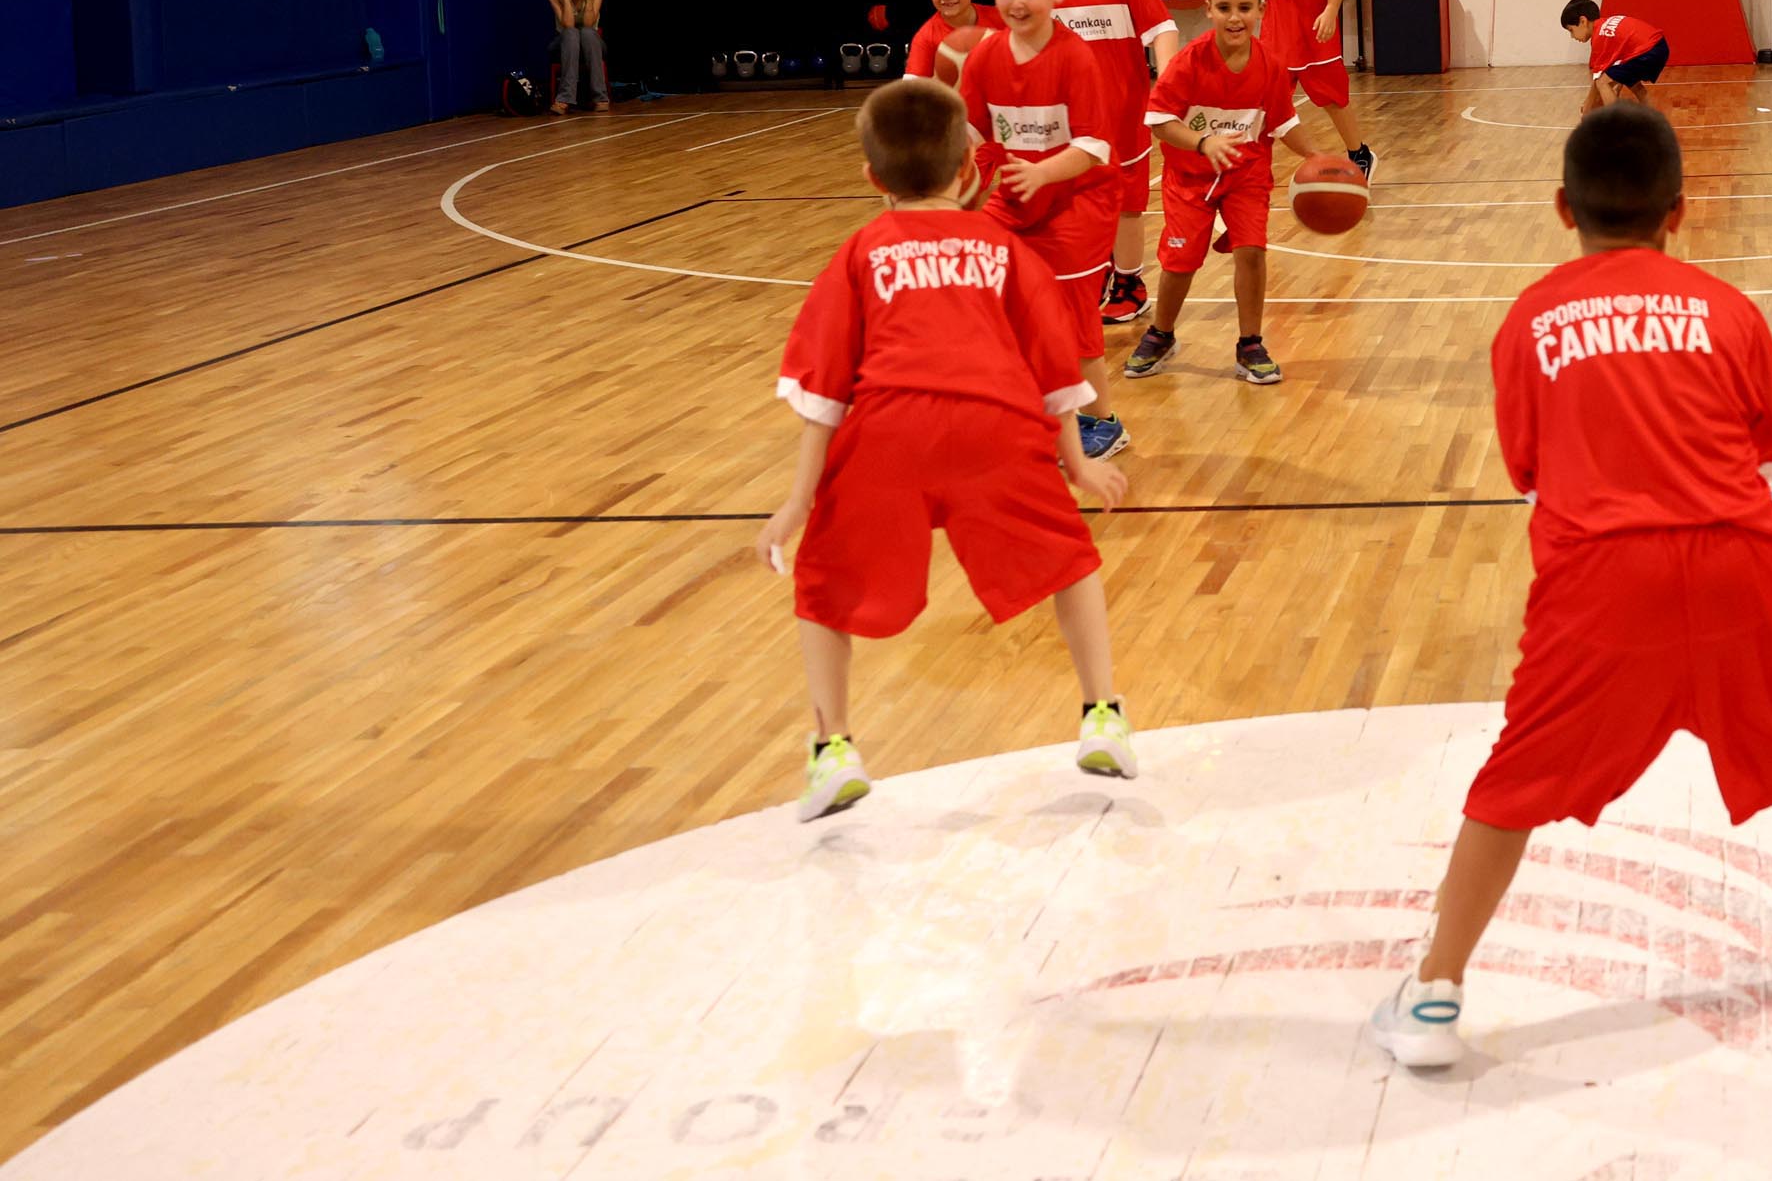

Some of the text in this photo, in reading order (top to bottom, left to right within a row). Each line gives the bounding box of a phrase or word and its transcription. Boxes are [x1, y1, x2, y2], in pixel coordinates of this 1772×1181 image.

[1068, 18, 1113, 30] Çankaya
[868, 239, 940, 269] SPORUN
[1531, 295, 1614, 339] SPORUN
[1536, 315, 1713, 383] ÇANKAYA
